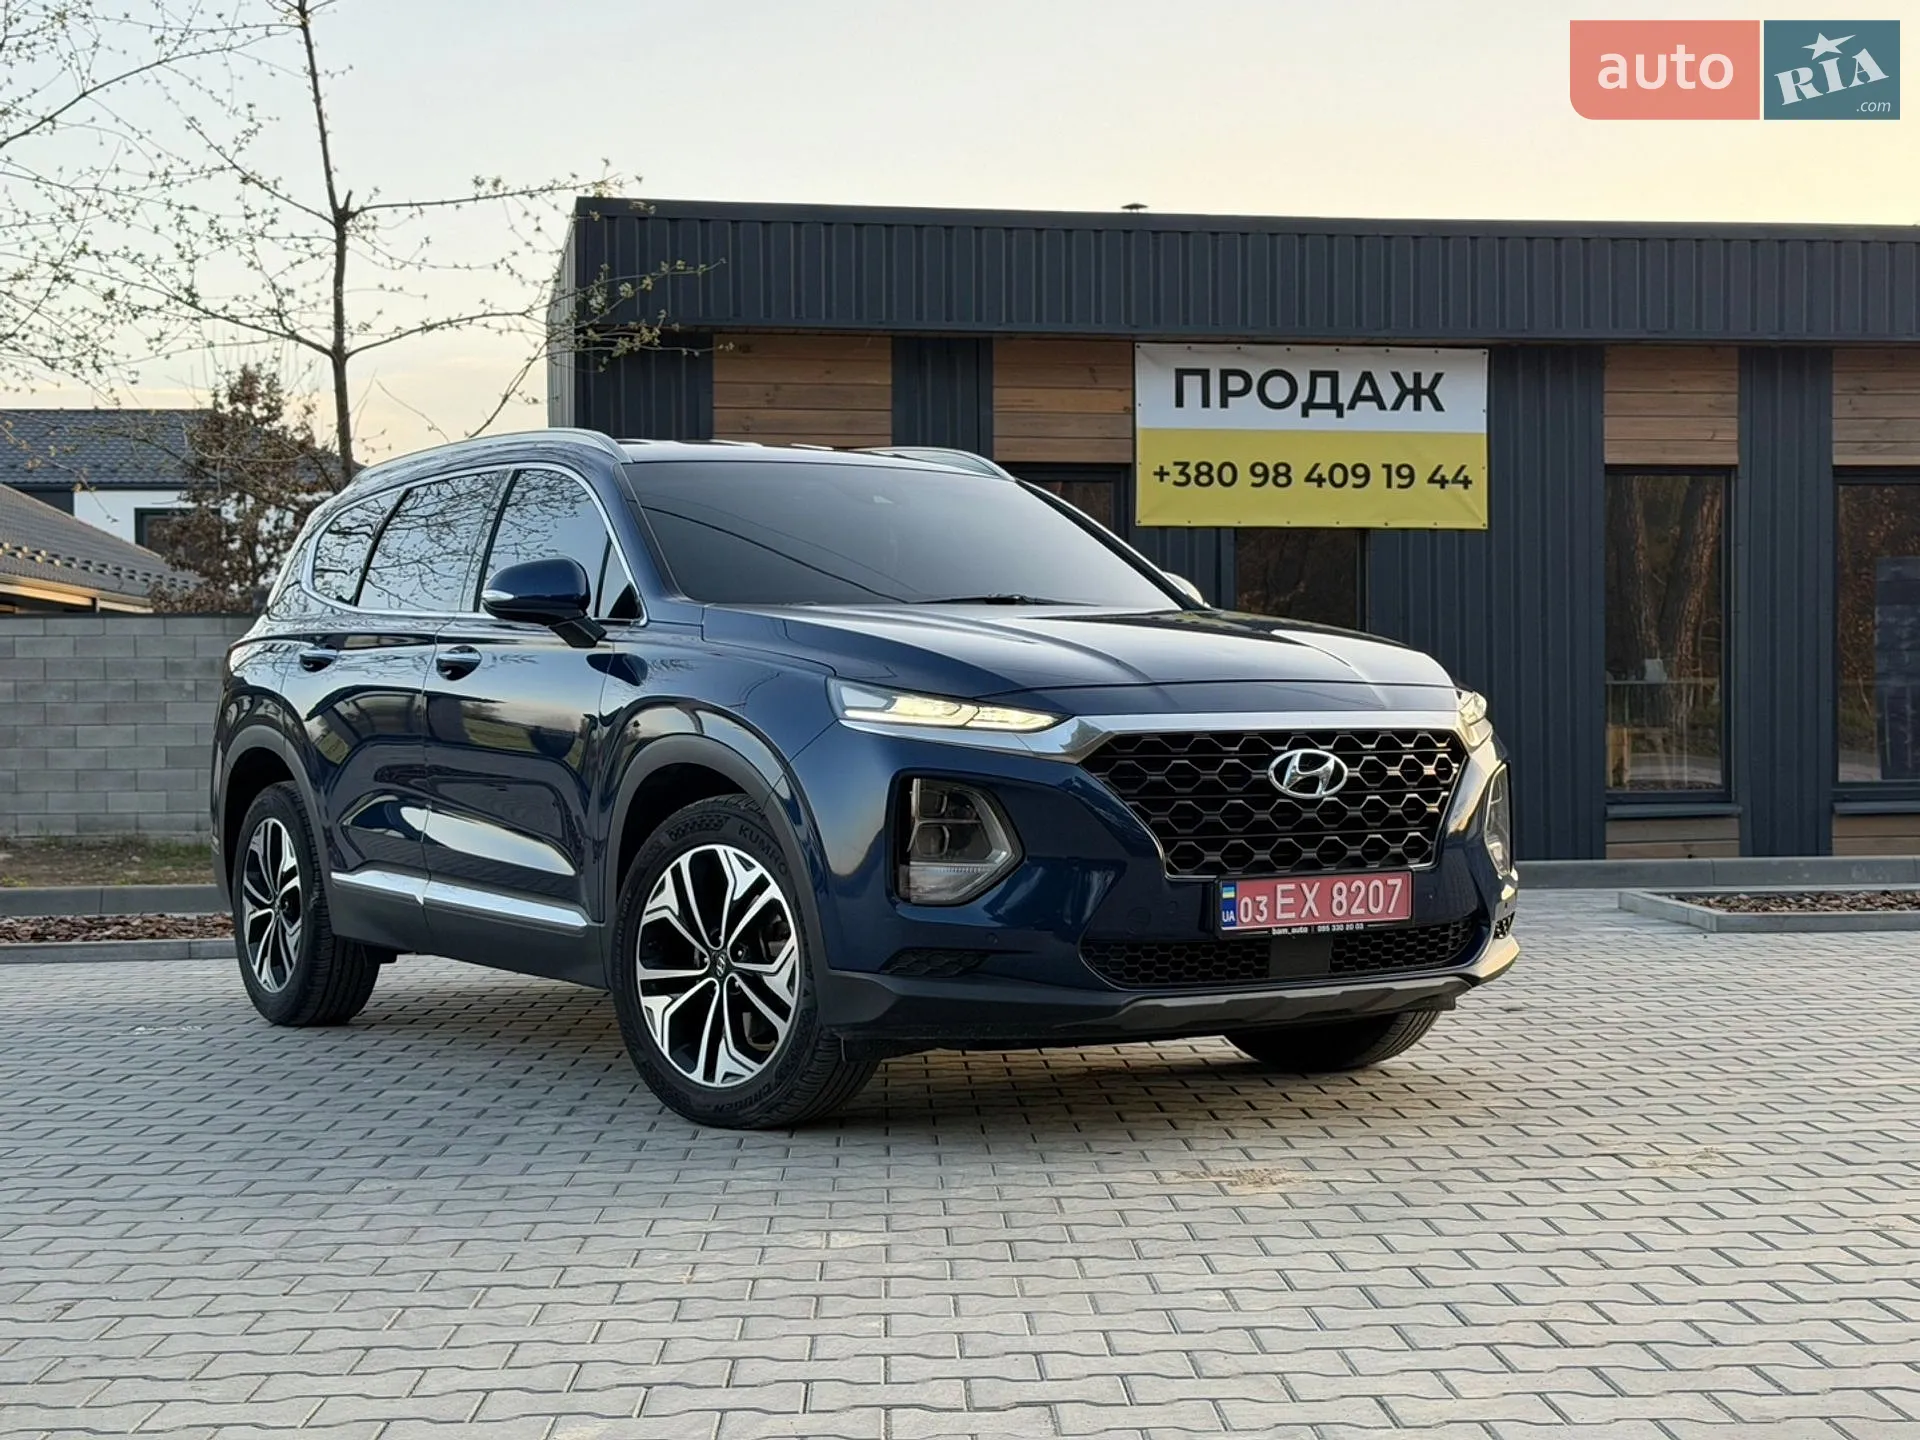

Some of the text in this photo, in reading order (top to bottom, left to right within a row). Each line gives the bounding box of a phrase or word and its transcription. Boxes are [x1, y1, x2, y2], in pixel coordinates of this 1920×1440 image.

[1174, 367, 1446, 419] ПРОДАЖ
[1152, 460, 1473, 490] +380 98 409 19 44
[1221, 911, 1236, 923] UA
[1239, 879, 1402, 924] 03 EX 8207
